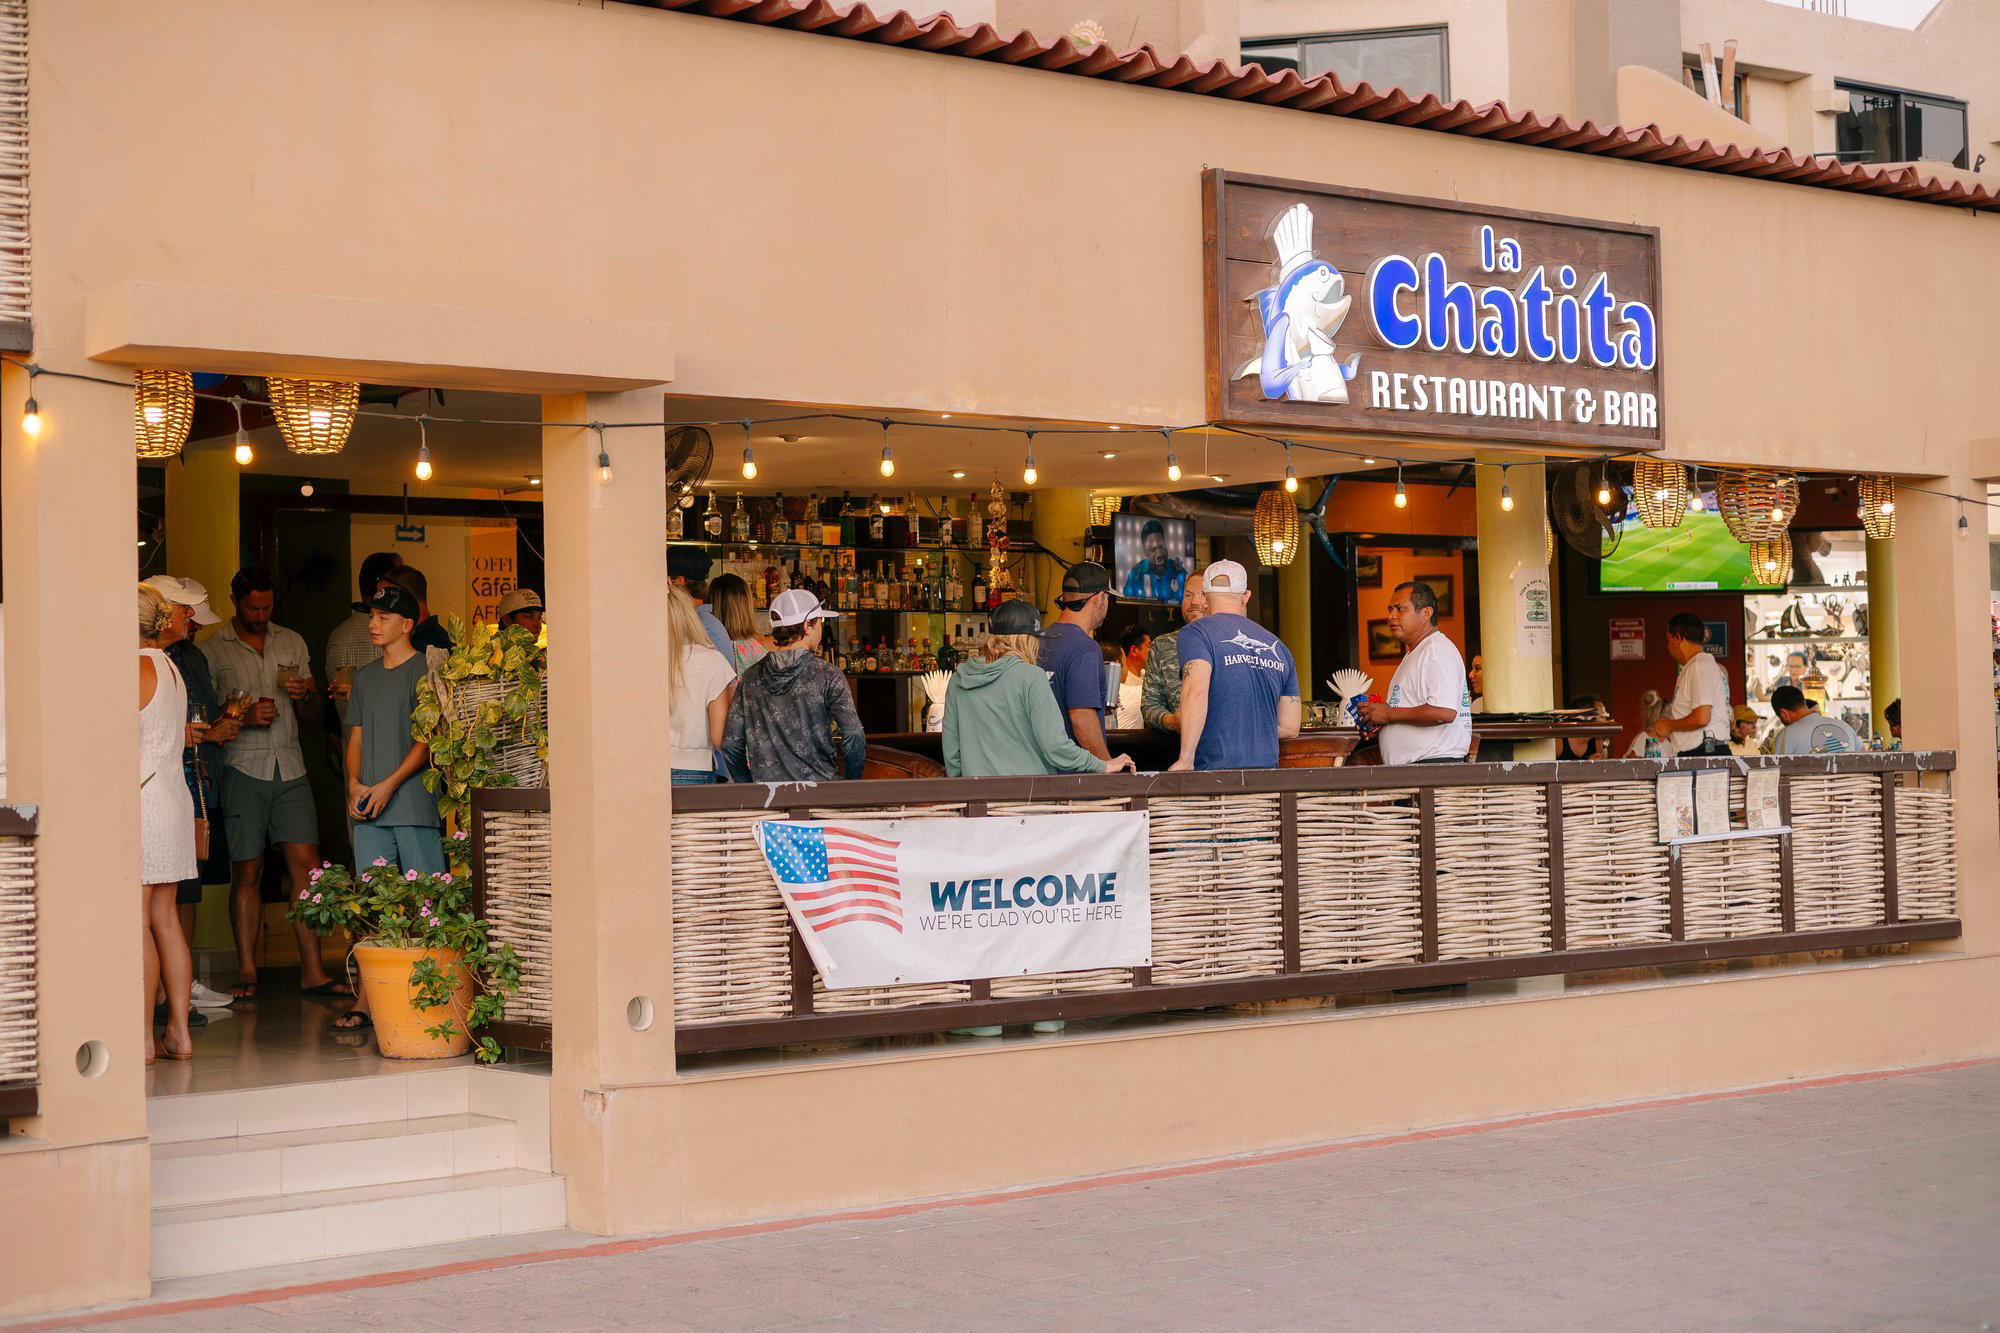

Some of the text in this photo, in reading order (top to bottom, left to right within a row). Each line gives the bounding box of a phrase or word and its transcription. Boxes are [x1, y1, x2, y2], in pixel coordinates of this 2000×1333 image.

[1480, 224, 1522, 273] la
[1371, 370, 1658, 428] RESTAURANT & BAR
[1223, 654, 1285, 673] HARVEST MOON
[929, 871, 1118, 912] WELCOME
[919, 904, 1123, 931] WE'RE GLAD YOU'RE HERE
